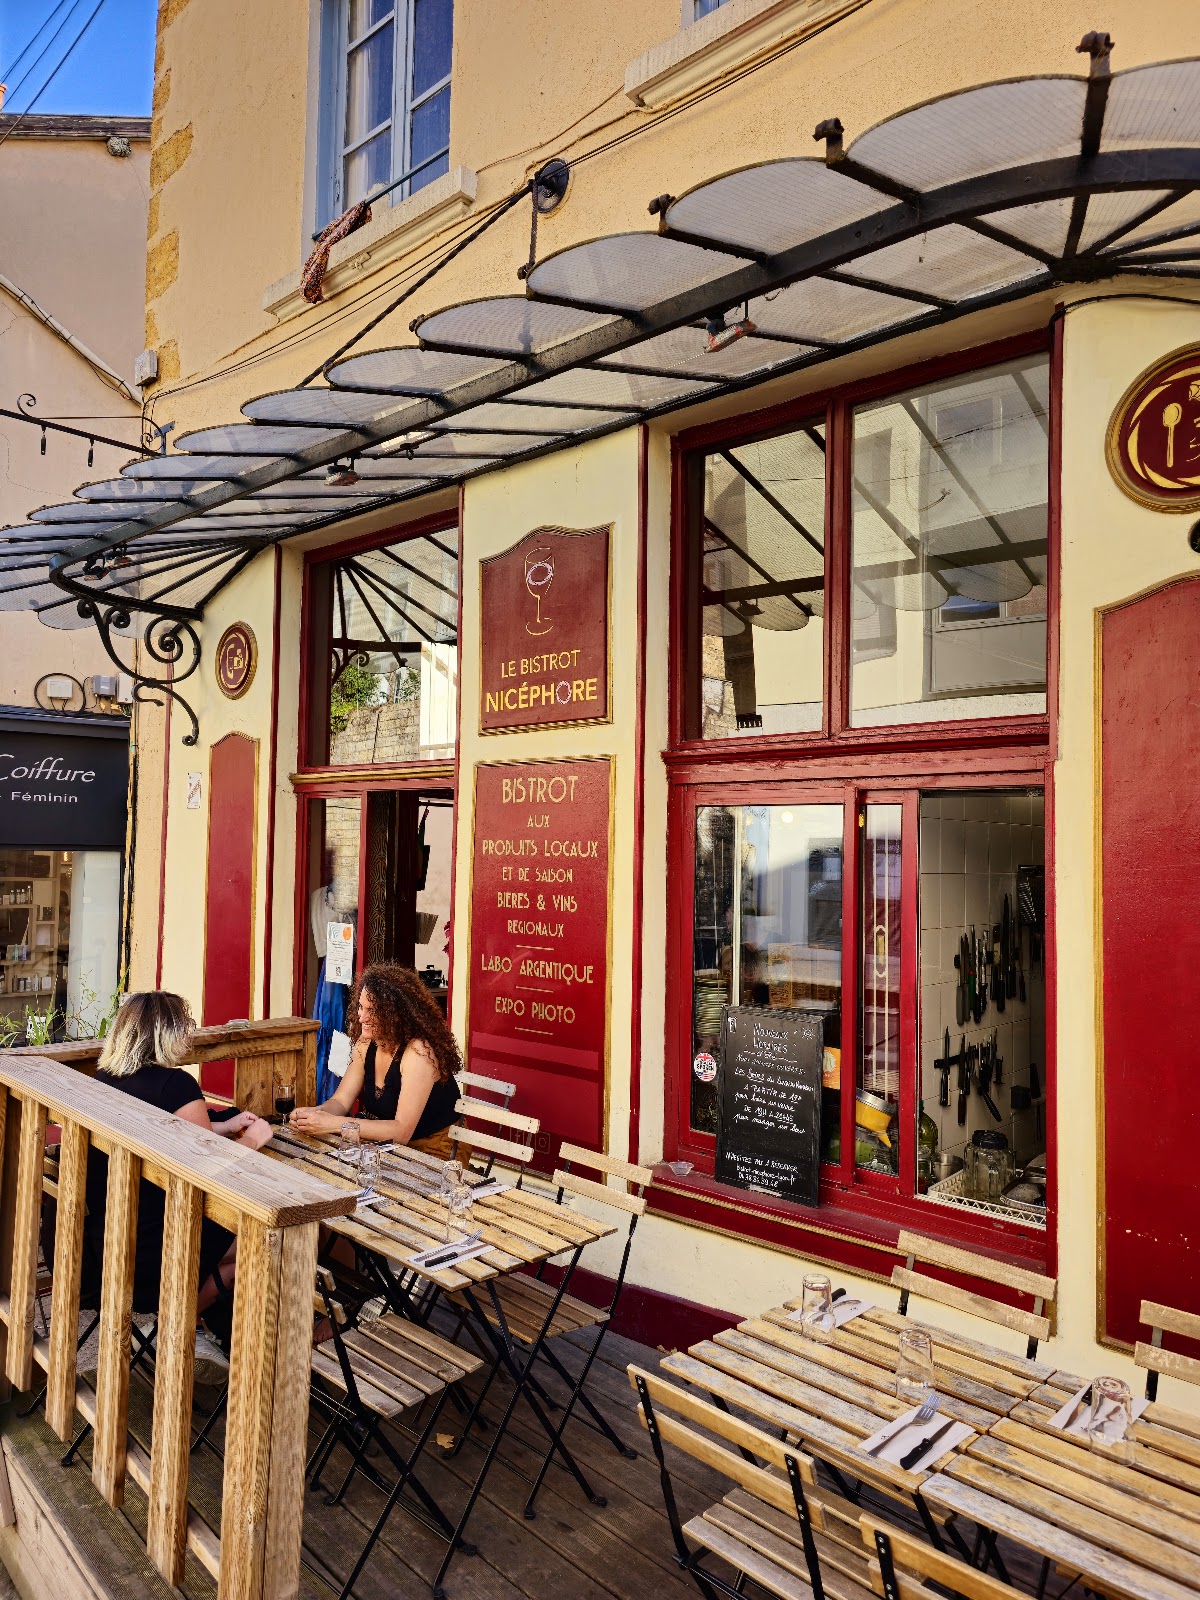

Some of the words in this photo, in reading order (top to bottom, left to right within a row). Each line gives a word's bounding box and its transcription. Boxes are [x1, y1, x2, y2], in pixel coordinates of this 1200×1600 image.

[501, 660, 516, 679] LE
[520, 649, 581, 676] BISTROT
[485, 678, 598, 713] NICÉPHORE
[11, 791, 78, 804] Féminin
[502, 775, 578, 804] BISTROT
[526, 814, 550, 828] AUX
[482, 840, 538, 857] PRODUITS
[544, 840, 598, 858] LOCAUX
[502, 866, 513, 881] ET
[518, 867, 530, 882] DE
[535, 867, 573, 884] SAISON
[497, 892, 530, 909] BIERES
[536, 894, 546, 910] &
[552, 895, 578, 913] VINS
[507, 920, 564, 938] REGIONAUX
[481, 953, 512, 974] LABO
[519, 960, 594, 986] ARGENTIQUE
[495, 996, 525, 1017] EXPO
[532, 1002, 576, 1024] PHOTO
